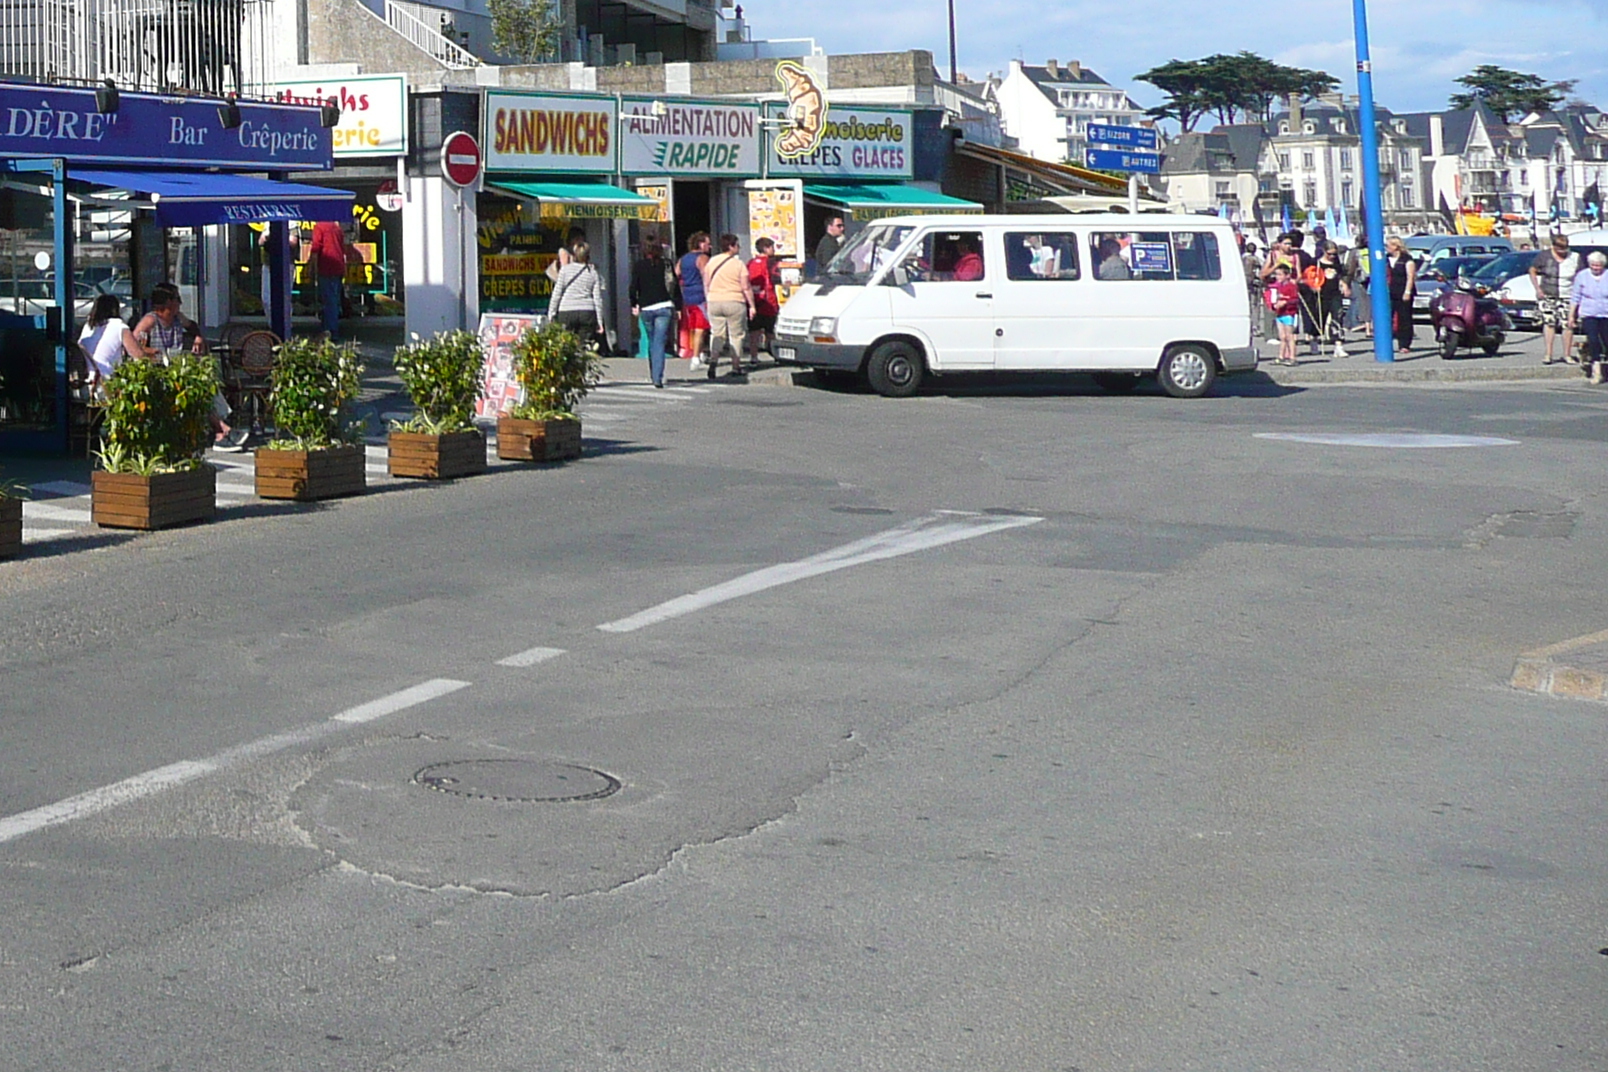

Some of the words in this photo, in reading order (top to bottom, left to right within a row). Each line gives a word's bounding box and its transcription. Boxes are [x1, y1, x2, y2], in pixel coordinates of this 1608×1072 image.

[494, 108, 609, 157] SANDWICHS
[629, 106, 753, 138] ALIMENTATION
[169, 115, 209, 146] Bar
[237, 120, 318, 156] Crêperie
[668, 141, 741, 169] RAPIDE
[852, 144, 905, 170] GLACES
[223, 204, 303, 219] RESTAURANT
[564, 204, 638, 217] VIENNOISERIE
[484, 257, 536, 271] SANDWICHS
[483, 279, 526, 297] CREPES
